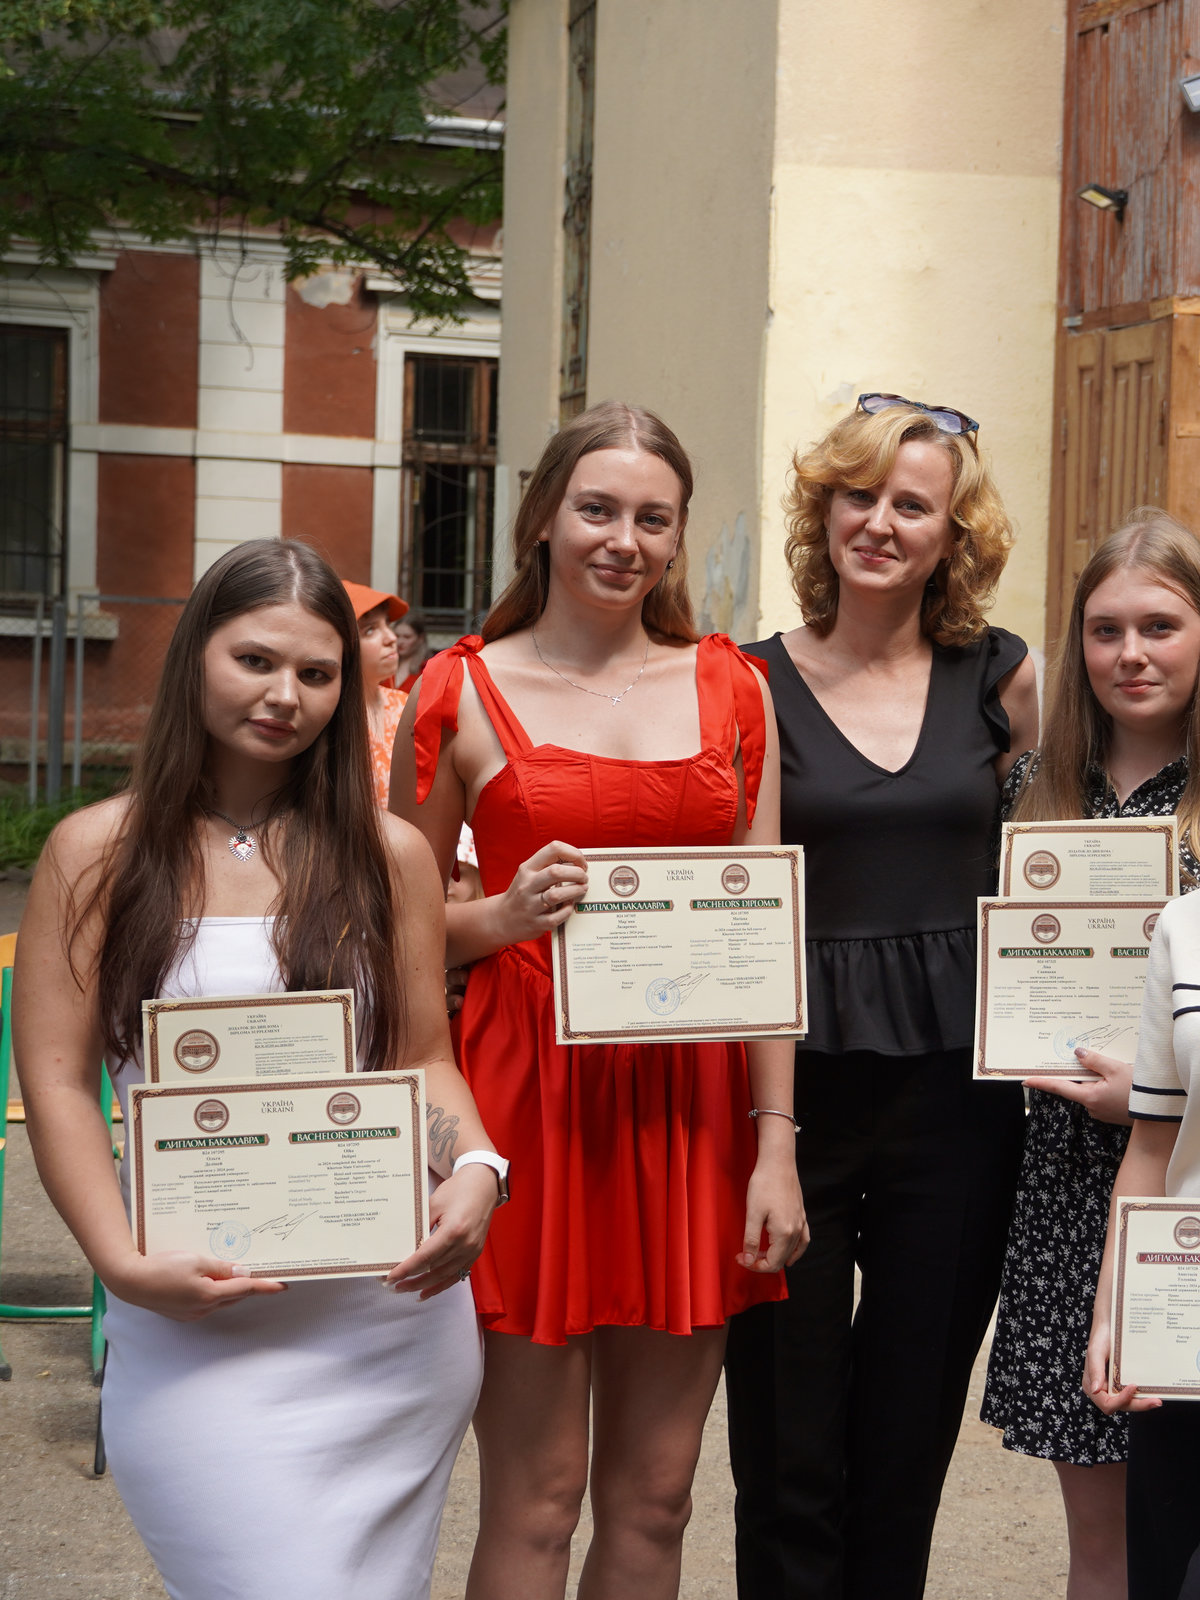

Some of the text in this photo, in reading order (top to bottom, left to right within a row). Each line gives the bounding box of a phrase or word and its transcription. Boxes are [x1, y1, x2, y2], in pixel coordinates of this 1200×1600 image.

[583, 901, 666, 912] ДИПЛОМ БАКАЛАВРА
[742, 899, 776, 907] DIPLOMA
[1118, 948, 1149, 956] BACHEL
[261, 1100, 294, 1108] УКРАЇНА
[261, 1106, 294, 1114] UKRAINE
[351, 1129, 393, 1139] DIPLOMA
[165, 1136, 260, 1149] ДИПЛОМ БАКАЛАВРА
[1145, 1254, 1182, 1263] ДИПЛОМ
